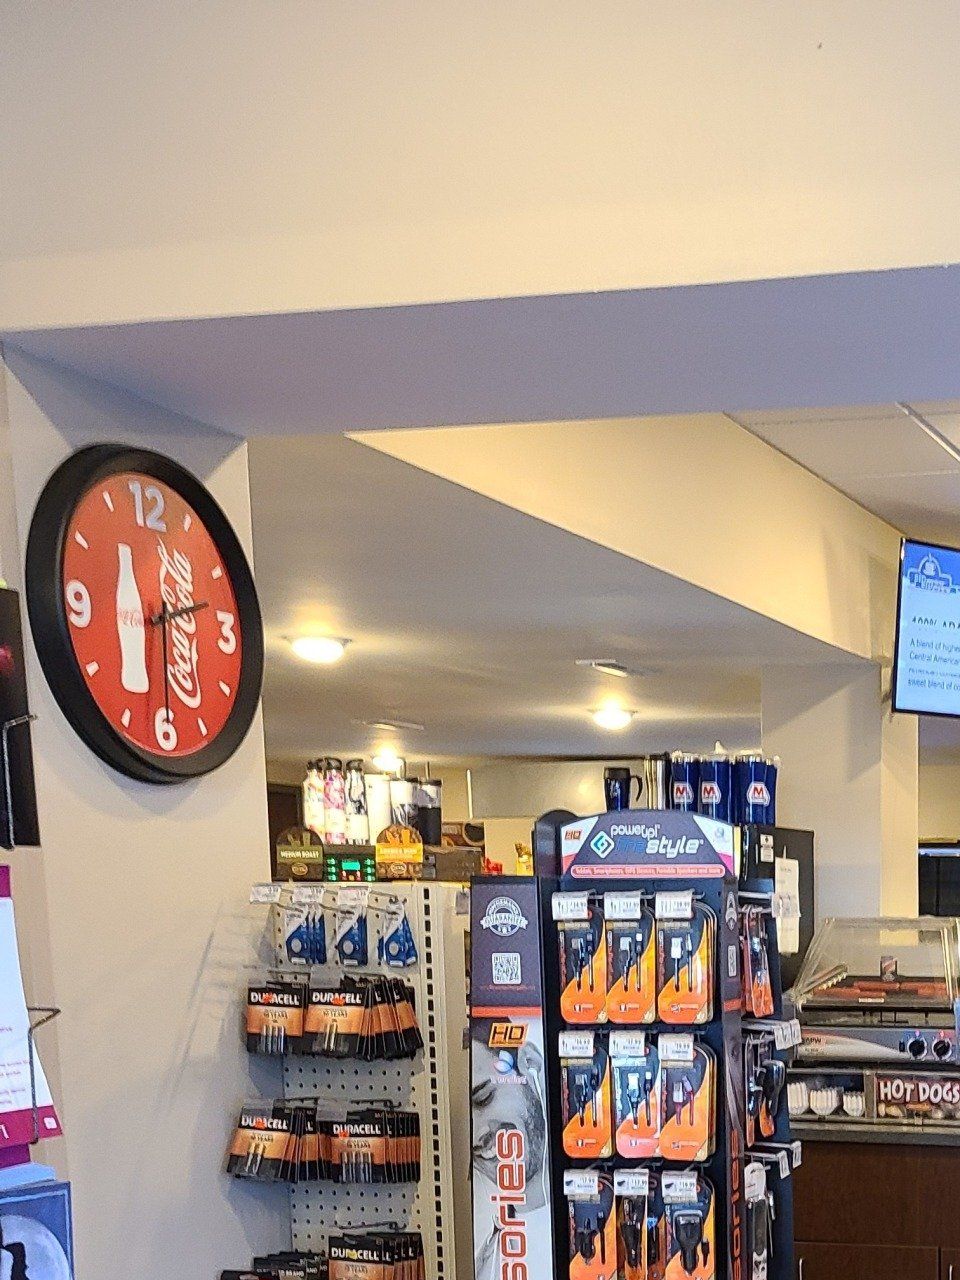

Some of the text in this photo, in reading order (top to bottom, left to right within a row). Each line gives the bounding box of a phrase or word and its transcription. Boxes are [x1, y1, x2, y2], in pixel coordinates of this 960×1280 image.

[129, 480, 167, 533] 12
[66, 580, 92, 628] 9
[216, 611, 237, 655] 3
[154, 706, 178, 750] 6
[250, 991, 300, 1006] DUACELL
[491, 1026, 525, 1045] HD
[880, 1079, 960, 1101] HOT DOGS
